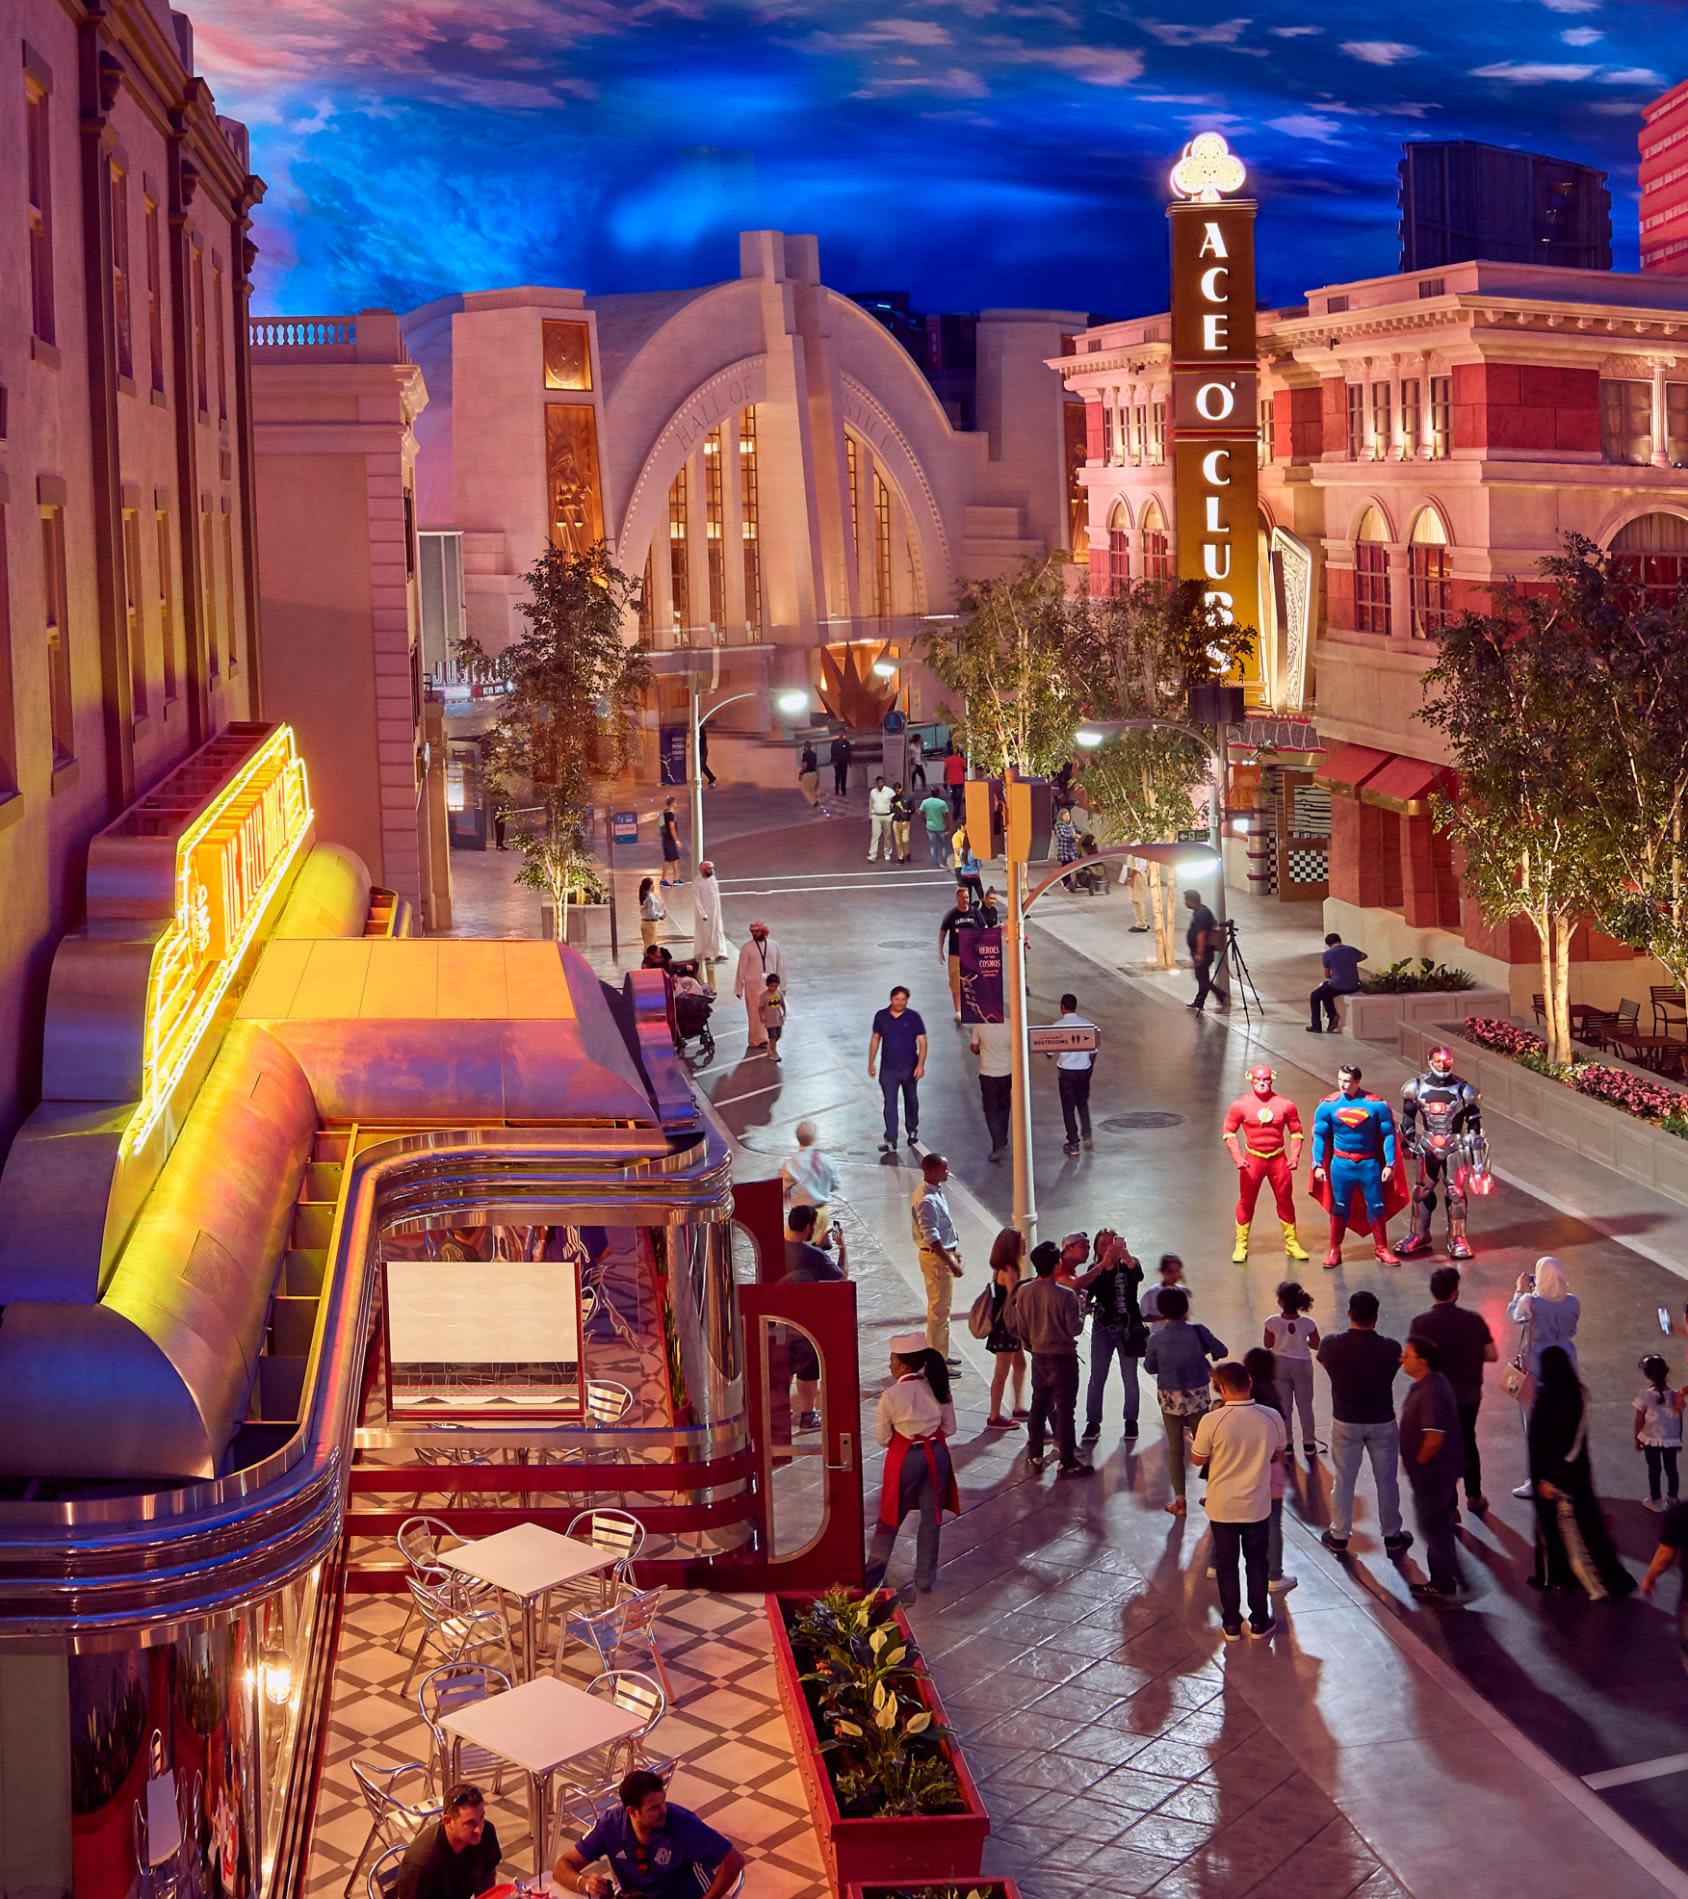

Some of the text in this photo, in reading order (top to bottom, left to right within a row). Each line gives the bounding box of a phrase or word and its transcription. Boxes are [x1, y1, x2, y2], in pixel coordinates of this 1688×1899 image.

[1196, 222, 1236, 674] ACE O' CLUBS
[978, 959, 1001, 968] COSMOS
